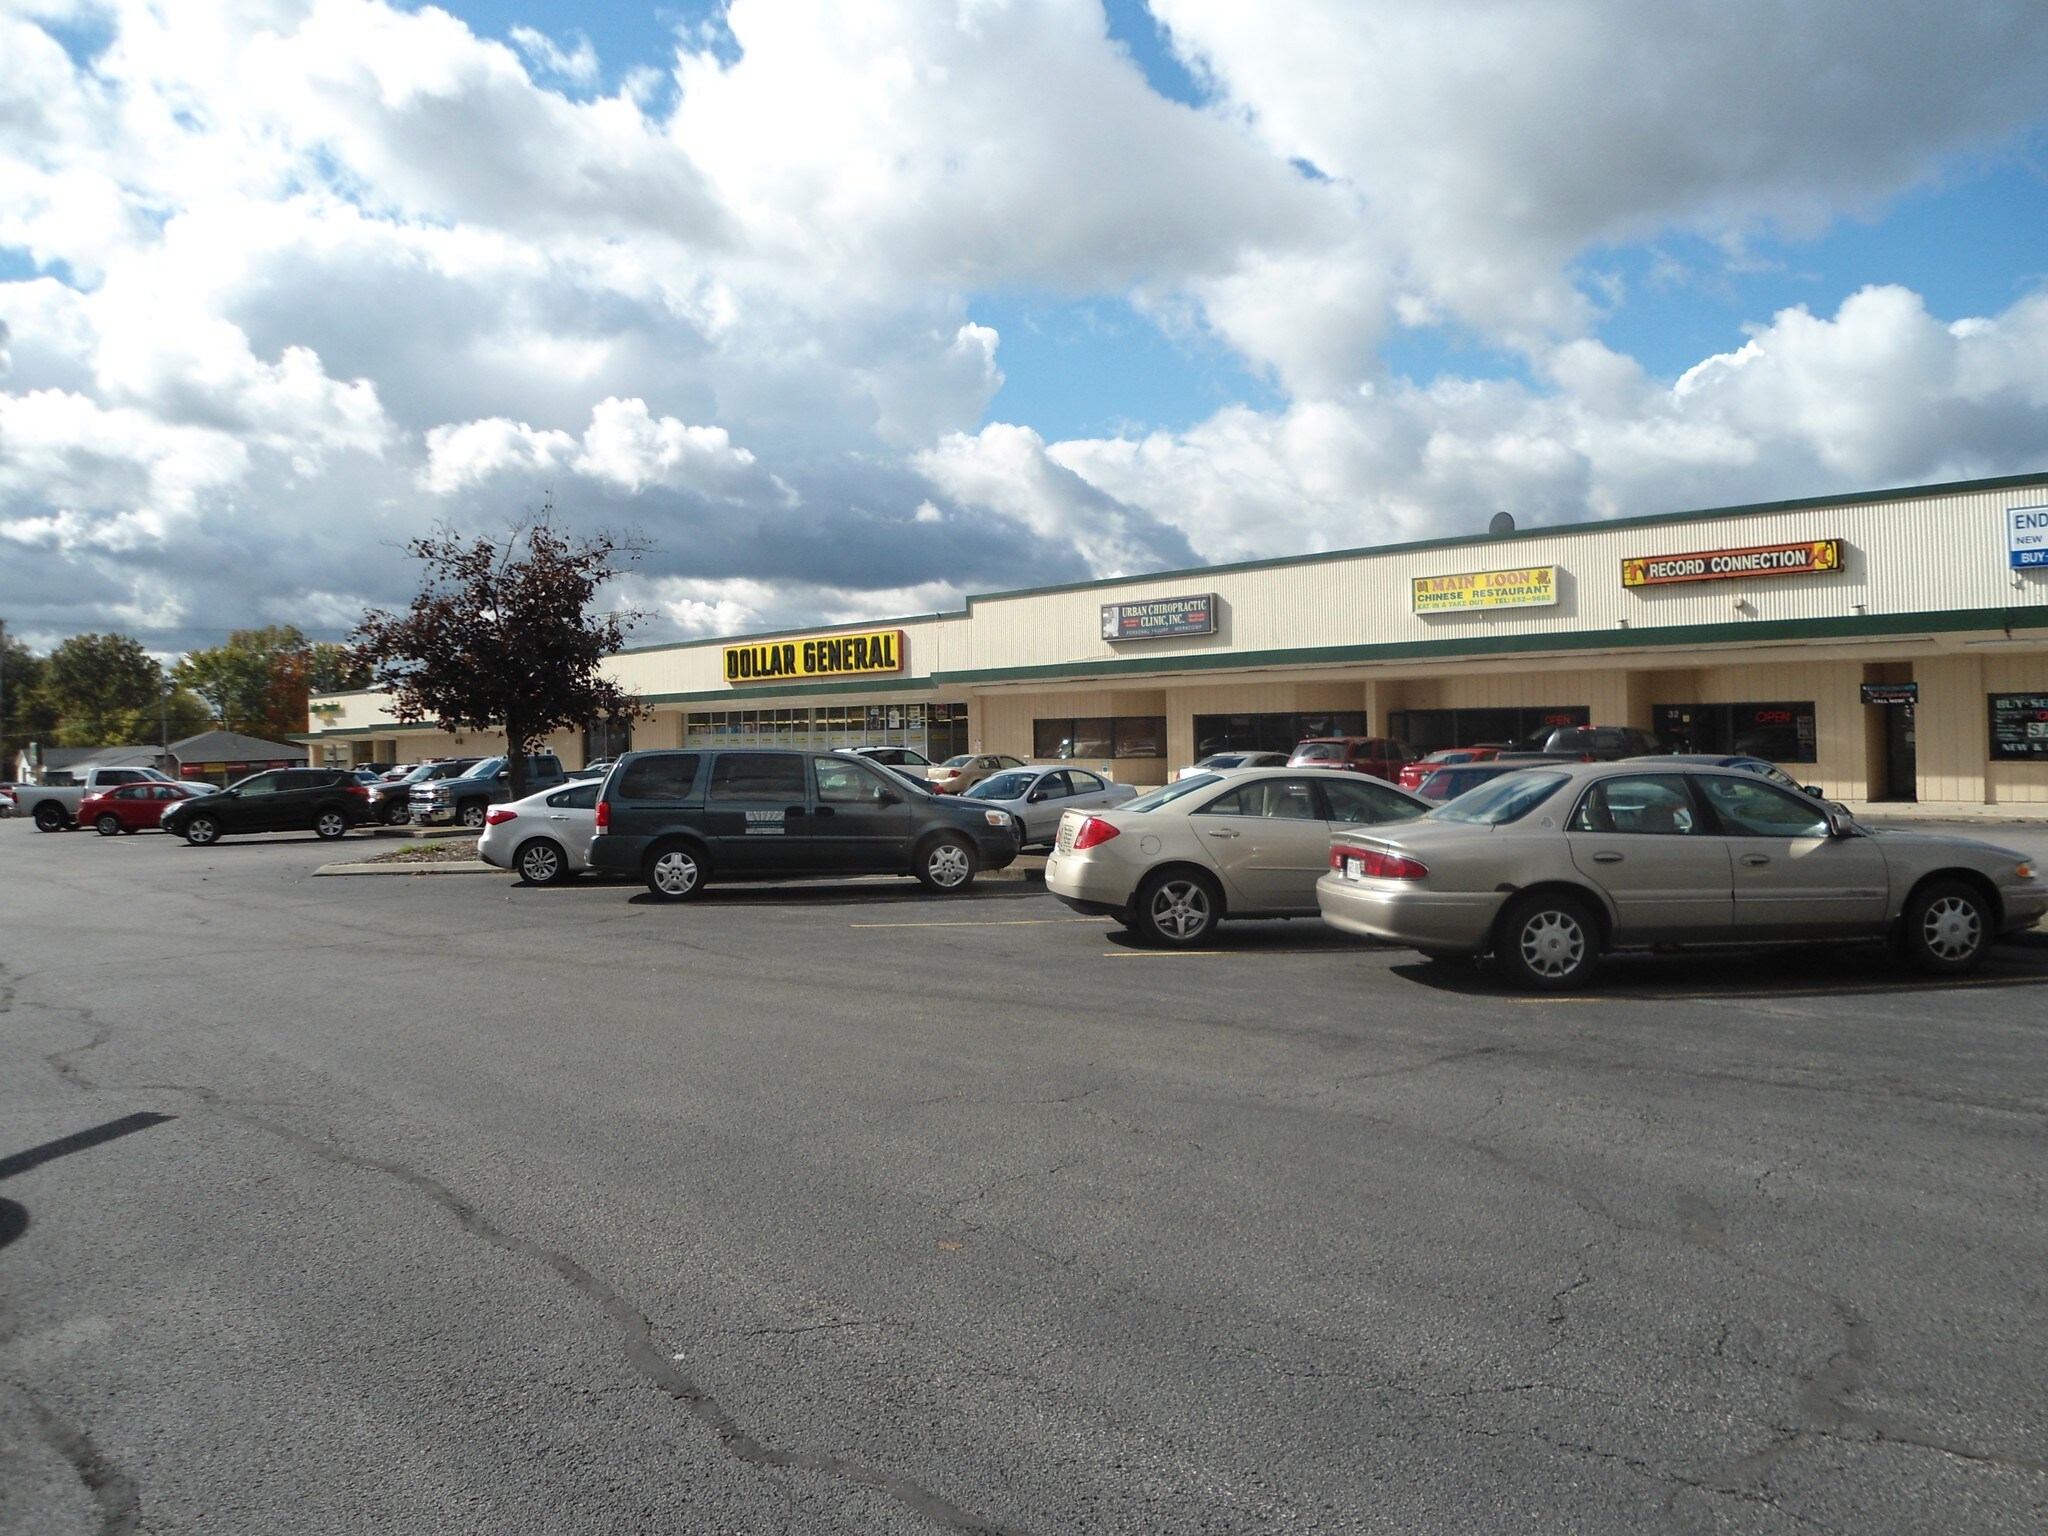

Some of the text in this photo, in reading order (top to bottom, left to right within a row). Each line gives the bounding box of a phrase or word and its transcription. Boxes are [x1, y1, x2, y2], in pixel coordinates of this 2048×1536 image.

[2016, 535, 2043, 544] NEW
[1650, 550, 1806, 578] RECORD CONNECTION
[1432, 576, 1475, 591] MAIN
[1486, 572, 1530, 587] LOON
[1417, 585, 1550, 602] CHINESE RESTAURANT
[1122, 600, 1207, 618] URBAN CHIROPRACTIC
[1140, 615, 1169, 627] CLINIC,
[1169, 614, 1185, 625] INC.
[1151, 627, 1169, 635] INJURY
[727, 635, 896, 679] DOLLAR GENERAL
[1544, 714, 1571, 725] OPEN
[1667, 710, 1679, 718] 32
[1755, 711, 1790, 723] OPEN
